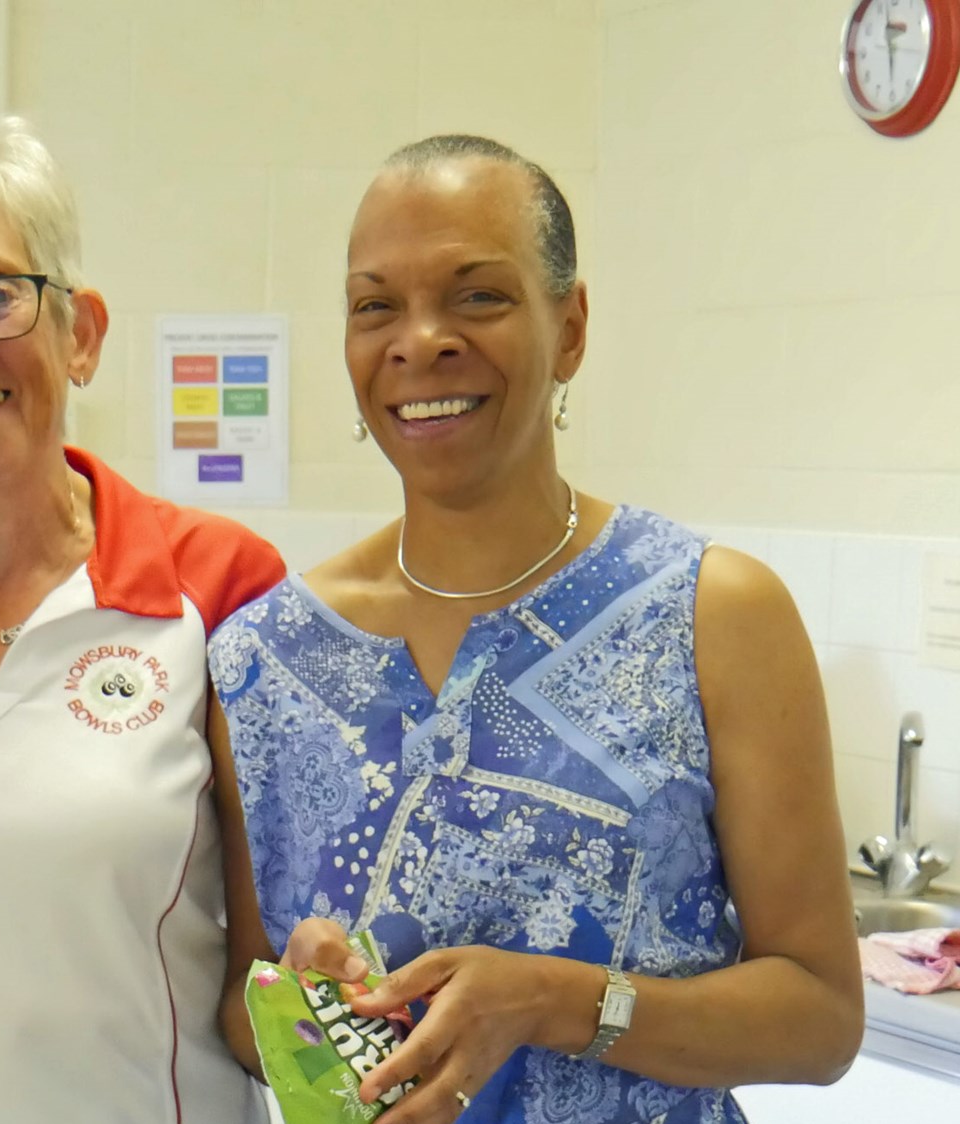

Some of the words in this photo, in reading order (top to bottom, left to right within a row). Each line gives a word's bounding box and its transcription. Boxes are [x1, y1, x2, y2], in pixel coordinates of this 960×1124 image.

[64, 645, 143, 692] MOWSBURY
[143, 656, 169, 693] PARK
[67, 698, 123, 735] BOWLS
[126, 699, 165, 731] CLUB
